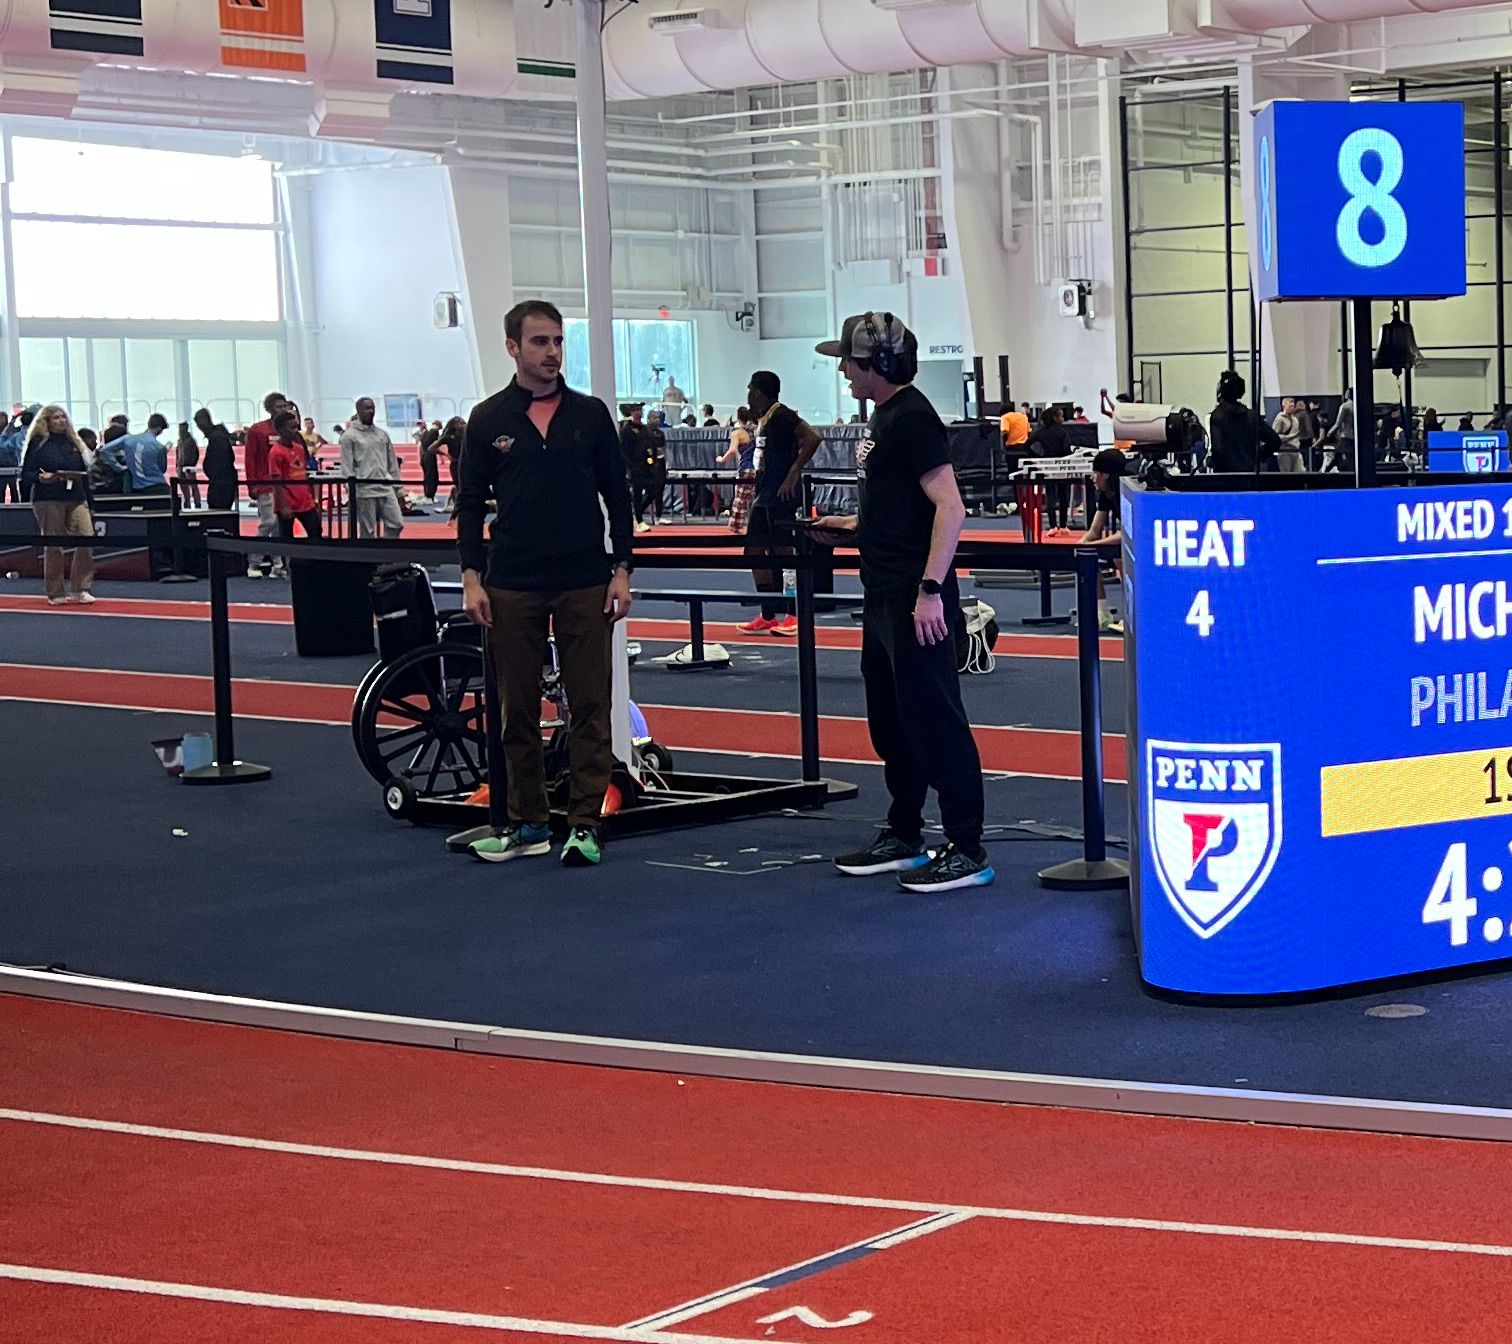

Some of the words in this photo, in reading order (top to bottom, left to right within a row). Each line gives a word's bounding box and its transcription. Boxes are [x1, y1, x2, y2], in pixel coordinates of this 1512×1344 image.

[1336, 127, 1408, 268] 8
[1154, 519, 1255, 568] HEAT
[1397, 499, 1495, 543] MIXED
[1185, 589, 1215, 638] 4
[1155, 756, 1265, 791] PENN
[1182, 812, 1239, 892] P
